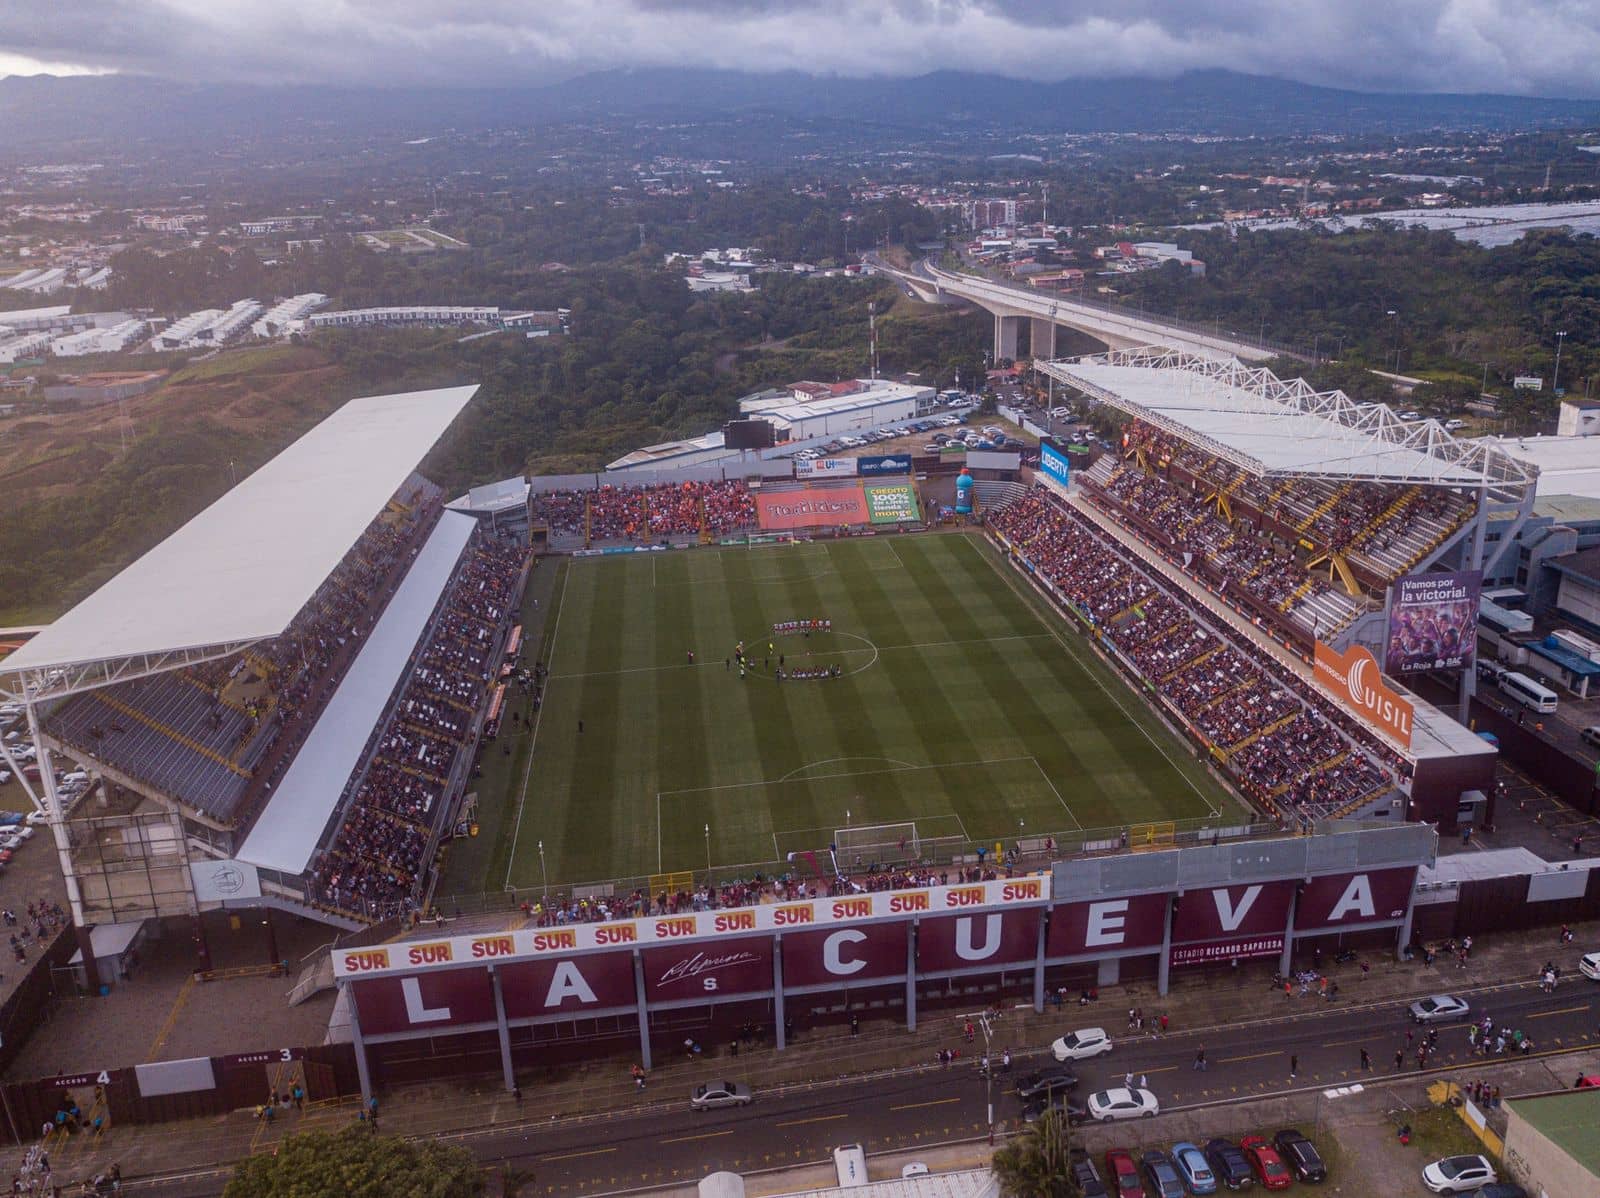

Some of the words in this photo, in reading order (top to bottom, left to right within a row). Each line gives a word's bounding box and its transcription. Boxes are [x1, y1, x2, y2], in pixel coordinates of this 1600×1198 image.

[1041, 450, 1067, 478] LIBERTY
[872, 493, 909, 501] 100%
[957, 490, 964, 499] G
[875, 510, 912, 518] monge
[1401, 590, 1412, 602] la
[1415, 586, 1466, 601] victoria!
[1402, 580, 1437, 590] ¡Vamos
[1438, 579, 1454, 589] por
[1401, 663, 1412, 671] La
[1413, 661, 1432, 671] Roja
[1446, 657, 1463, 668] BAC
[1365, 686, 1409, 735] UISIL
[947, 888, 982, 907] SUR
[1003, 882, 1038, 901] SUR
[832, 900, 869, 919] SUR
[890, 894, 927, 912] SUR
[716, 913, 753, 932] SUR
[774, 907, 811, 925] SUR
[596, 926, 635, 945] SUR
[656, 919, 695, 938] SUR
[472, 939, 513, 958] SUR
[535, 932, 575, 951] SUR
[1174, 948, 1204, 960] ESTADIO
[1206, 944, 1241, 956] RICARDO
[1242, 940, 1283, 953] SAPRISSA
[346, 952, 387, 971] SUR
[409, 946, 450, 965] SUR
[703, 977, 718, 991] S
[280, 1048, 292, 1062] 3
[97, 1070, 110, 1084] 4
